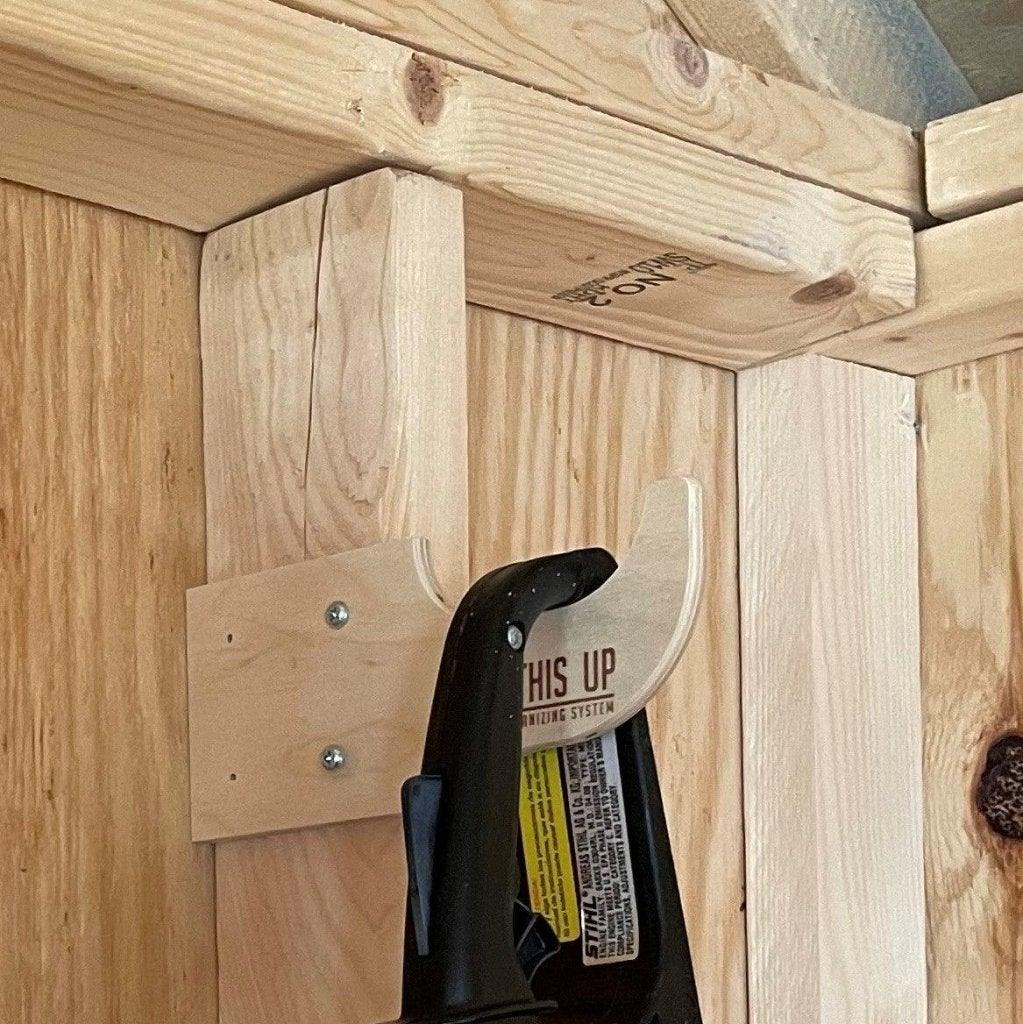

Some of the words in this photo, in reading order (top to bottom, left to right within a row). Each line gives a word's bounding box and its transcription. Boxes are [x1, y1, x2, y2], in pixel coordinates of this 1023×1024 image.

[523, 656, 567, 702] HIS
[584, 647, 615, 692] UP
[571, 701, 614, 720] SYSTEM
[583, 895, 598, 959] STIHL
